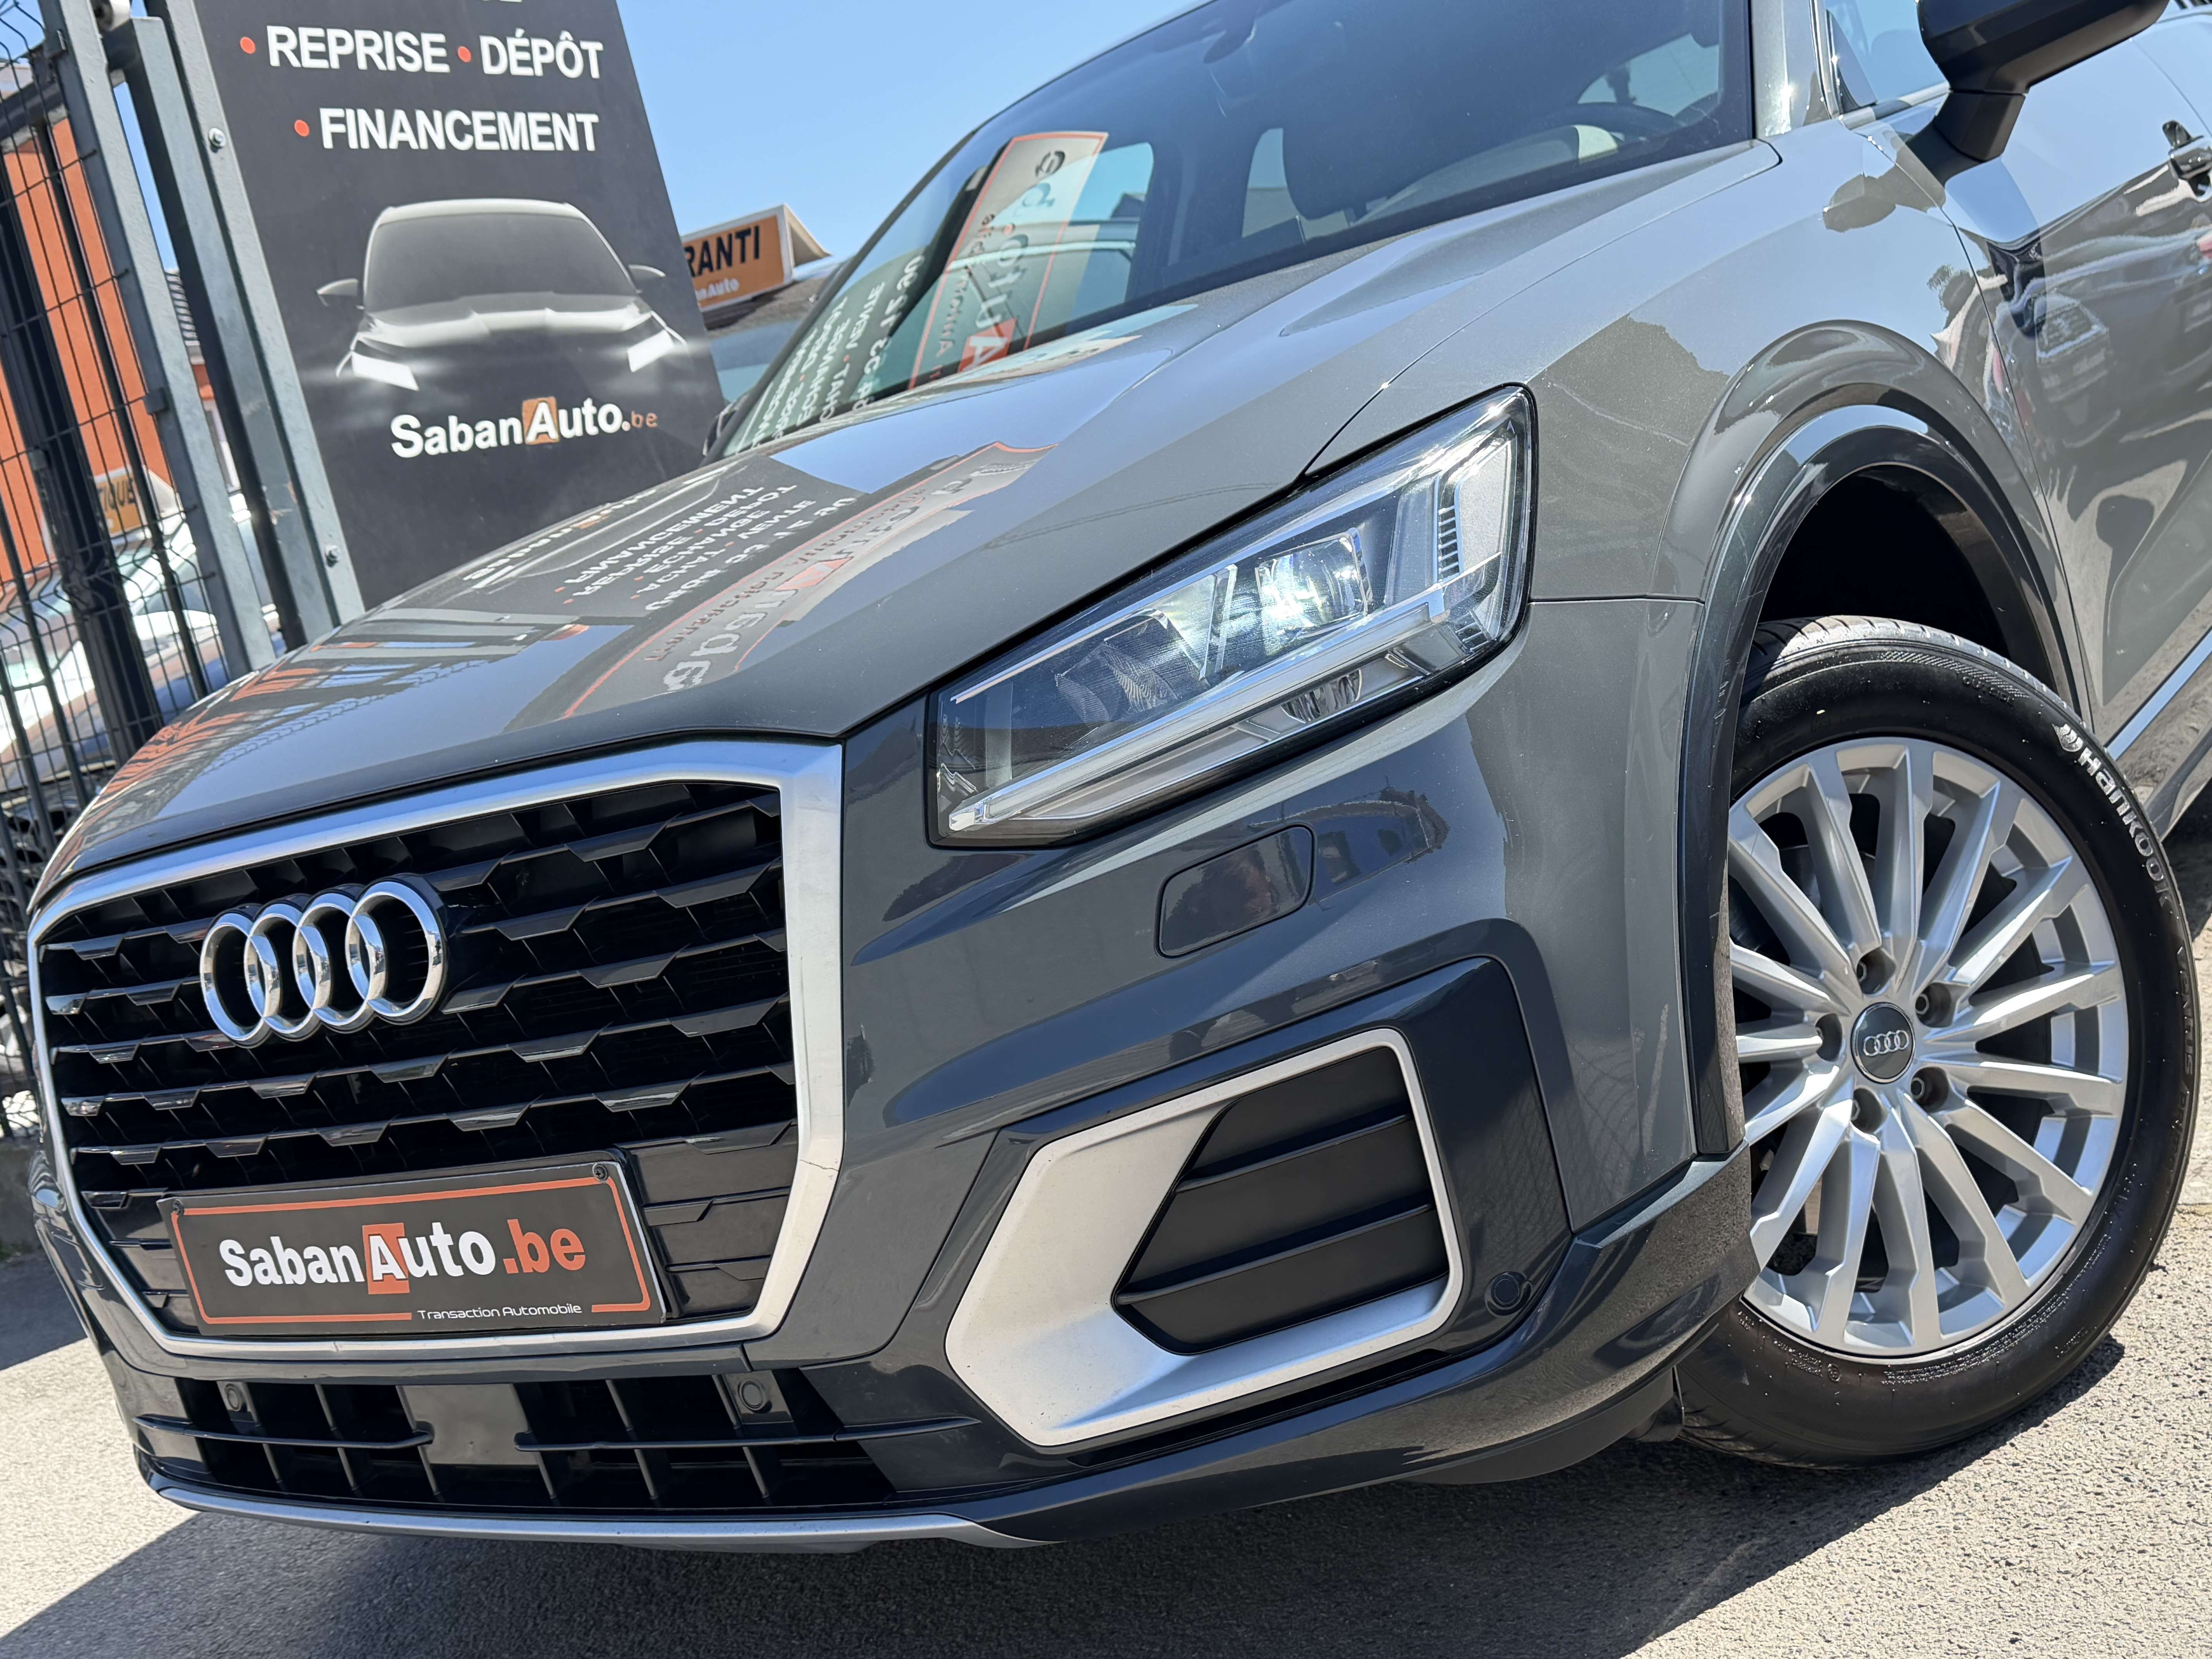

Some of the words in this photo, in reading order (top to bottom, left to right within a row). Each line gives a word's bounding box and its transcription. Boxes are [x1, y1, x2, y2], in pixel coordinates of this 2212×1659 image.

[266, 25, 450, 73] REPRISE
[479, 29, 604, 79] DÉPÔT
[319, 107, 599, 151] FINANCEMENT
[390, 398, 658, 458] SabanAuto.be
[2078, 747, 2174, 908] Hankook
[219, 1218, 586, 1287] SabanAuto.be
[417, 1307, 500, 1320] Transaction
[502, 1303, 582, 1317] Automobile
